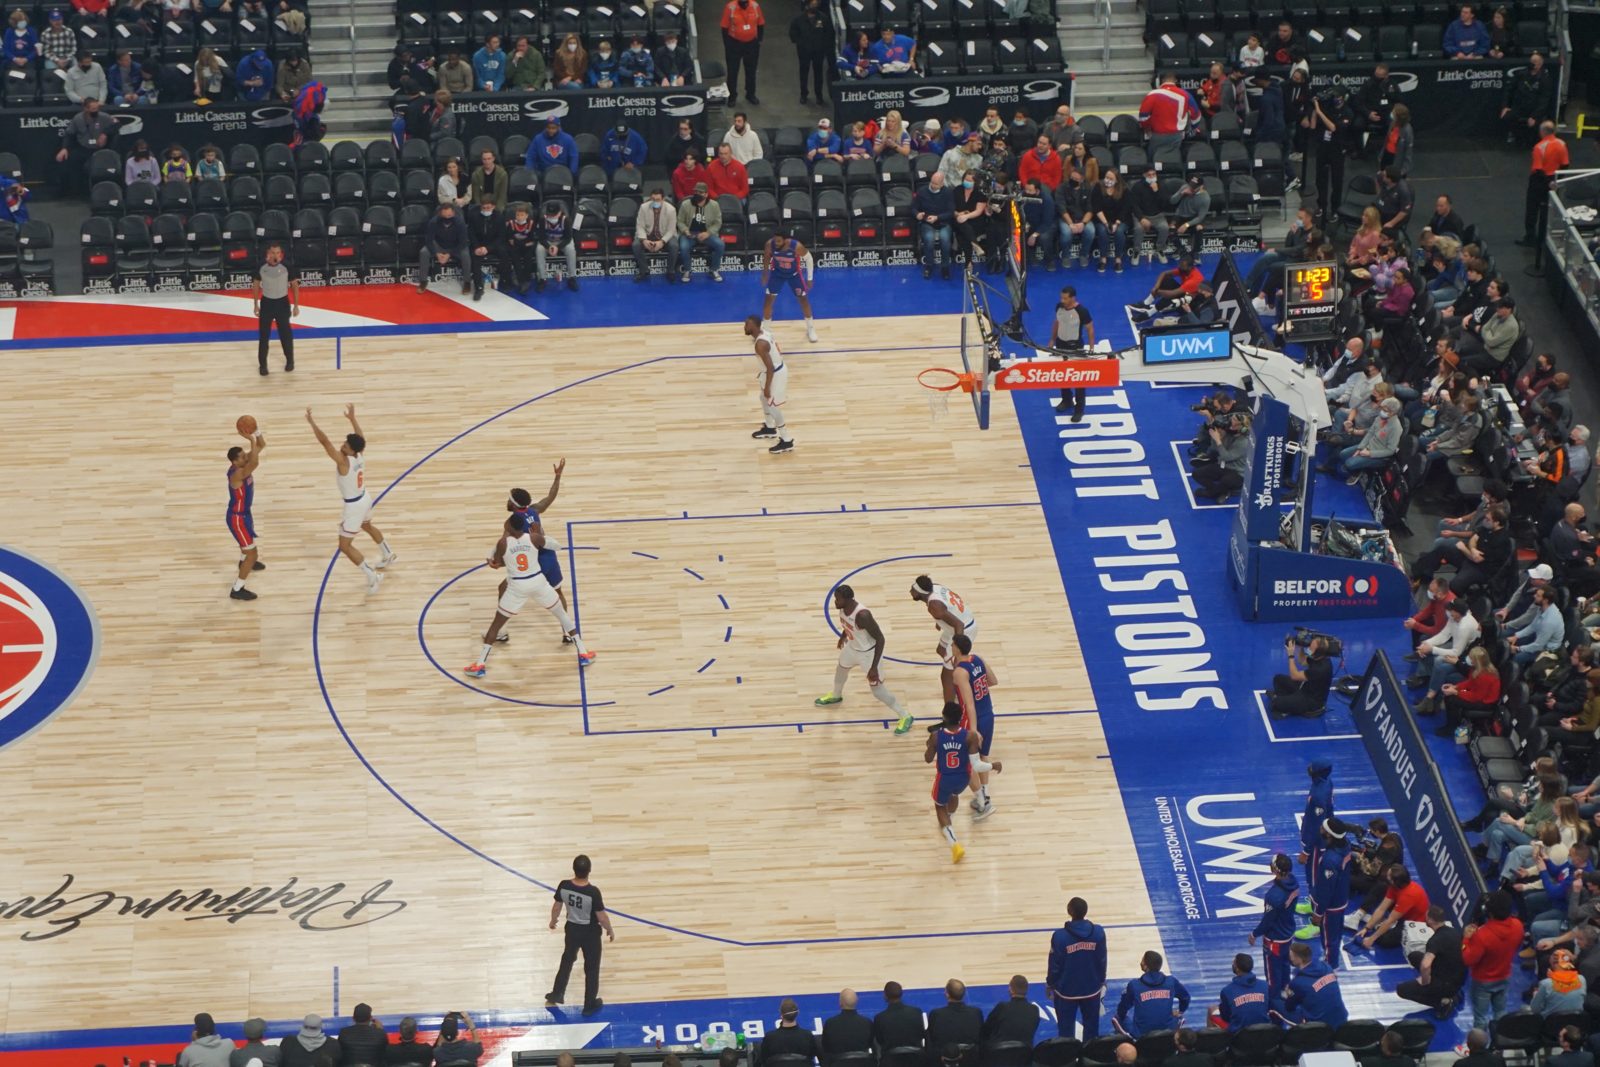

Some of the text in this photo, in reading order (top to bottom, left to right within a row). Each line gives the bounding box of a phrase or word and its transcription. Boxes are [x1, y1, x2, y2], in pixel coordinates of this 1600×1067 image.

[1437, 69, 1503, 81] Little Caesars
[1470, 79, 1503, 89] arena
[841, 90, 904, 102] Little Caesars
[955, 85, 1018, 97] Little Caesars
[588, 96, 656, 108] Little Caesars
[874, 100, 905, 109] arena
[988, 95, 1018, 104] arena
[451, 102, 519, 113] Little Caesars
[624, 106, 656, 116] arena
[20, 118, 48, 128] Little
[175, 111, 246, 123] Little Caesars
[487, 112, 520, 122] arena
[212, 121, 247, 131] arena
[720, 263, 744, 272] aesars
[1296, 267, 1330, 283] 11:23
[1311, 282, 1323, 300] 5
[1301, 305, 1335, 315] TISSOT
[1160, 335, 1215, 356] UWM
[1273, 436, 1284, 489] SPORTSBOOK
[1263, 435, 1276, 507] DRAFTKINGS
[516, 553, 528, 572] 9
[1274, 580, 1342, 594] BELFOR
[1273, 599, 1318, 607] PROPERTY
[1087, 518, 1229, 711] PISTONS
[973, 674, 989, 701] 55
[1374, 701, 1417, 800] FANDUEL
[946, 751, 960, 768] 6
[1155, 796, 1200, 920] UNITED WHOLESALE MORTGAGE
[1185, 792, 1277, 919] UWM
[1425, 821, 1470, 929] FANDUEL
[568, 894, 583, 909] 52
